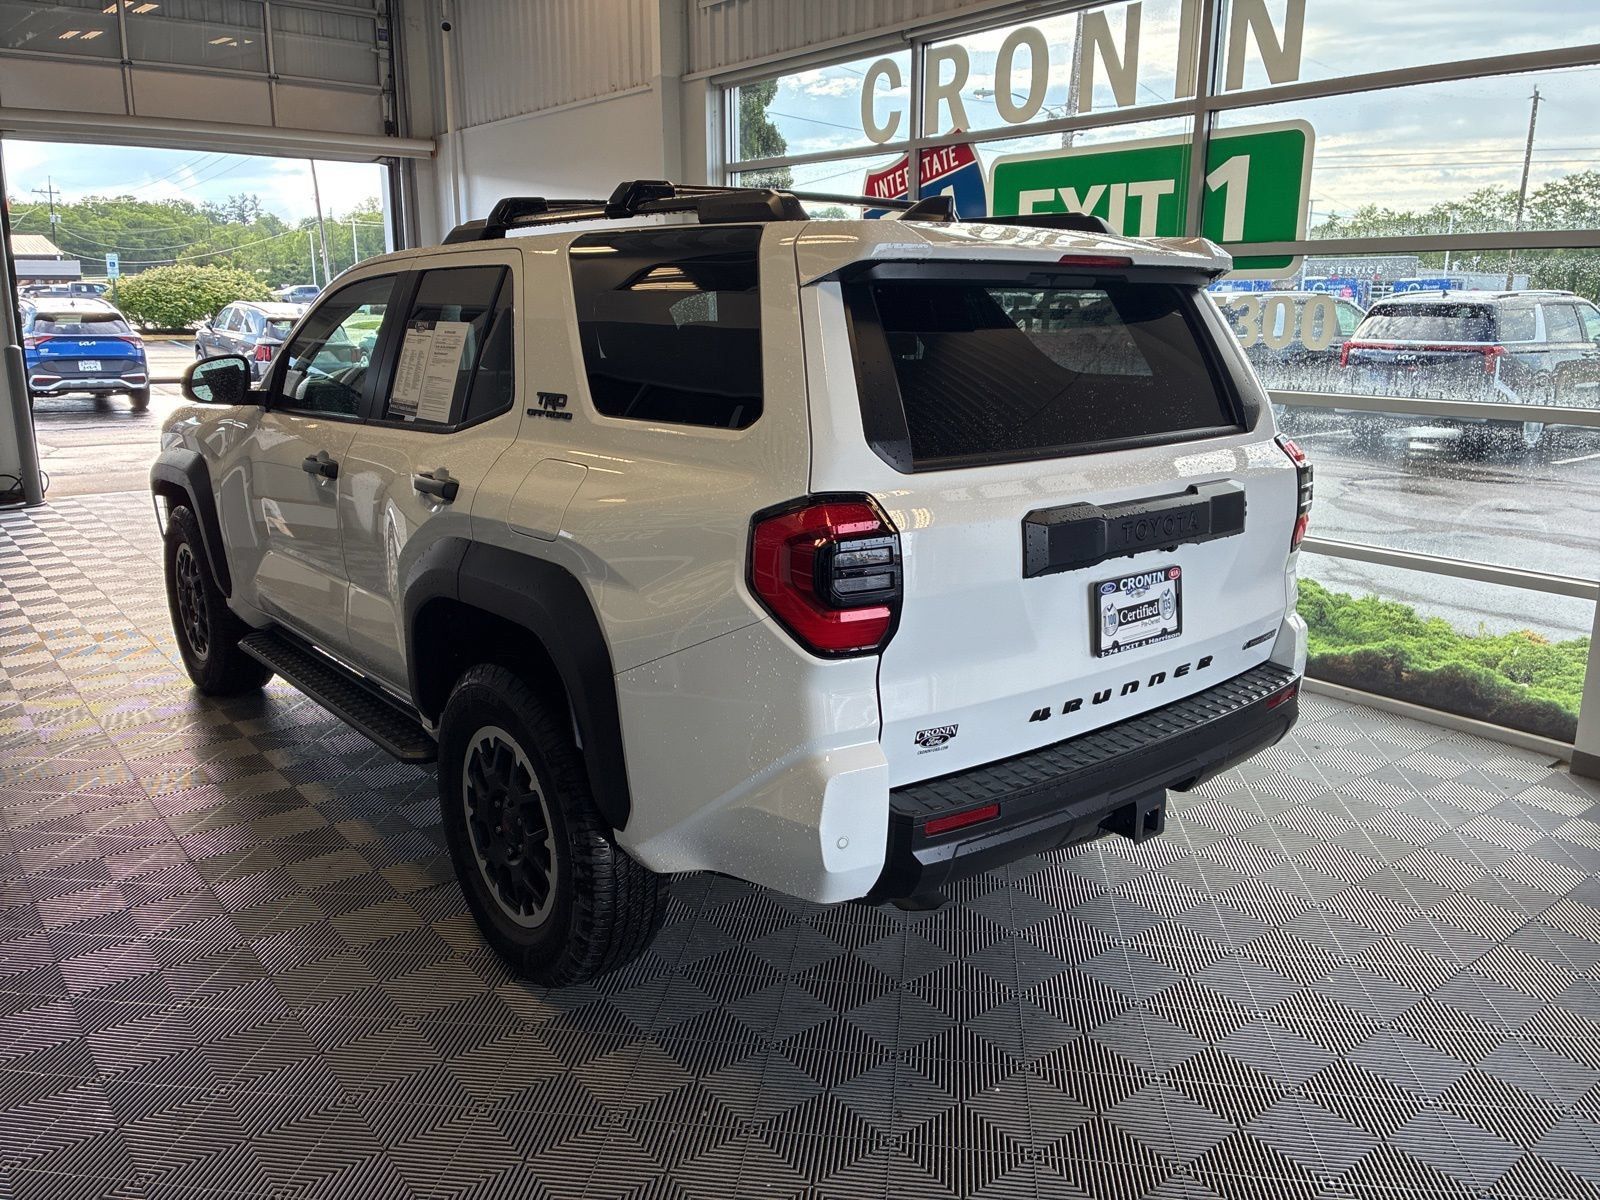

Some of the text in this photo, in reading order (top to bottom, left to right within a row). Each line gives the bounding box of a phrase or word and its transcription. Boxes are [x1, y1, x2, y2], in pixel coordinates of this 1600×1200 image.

[861, 0, 1303, 144] CRONIN
[1205, 154, 1251, 242] 1
[1329, 265, 1384, 275] SERVICE
[1122, 508, 1199, 543] TOYOTA
[1120, 570, 1164, 592] CRONIN
[1120, 601, 1158, 623] Certified
[1101, 648, 1119, 659] I-74
[1120, 641, 1140, 652] EXIT
[1148, 632, 1181, 645] Harrison
[1029, 655, 1214, 723] 4RUNNER
[916, 725, 957, 740] CRONIN
